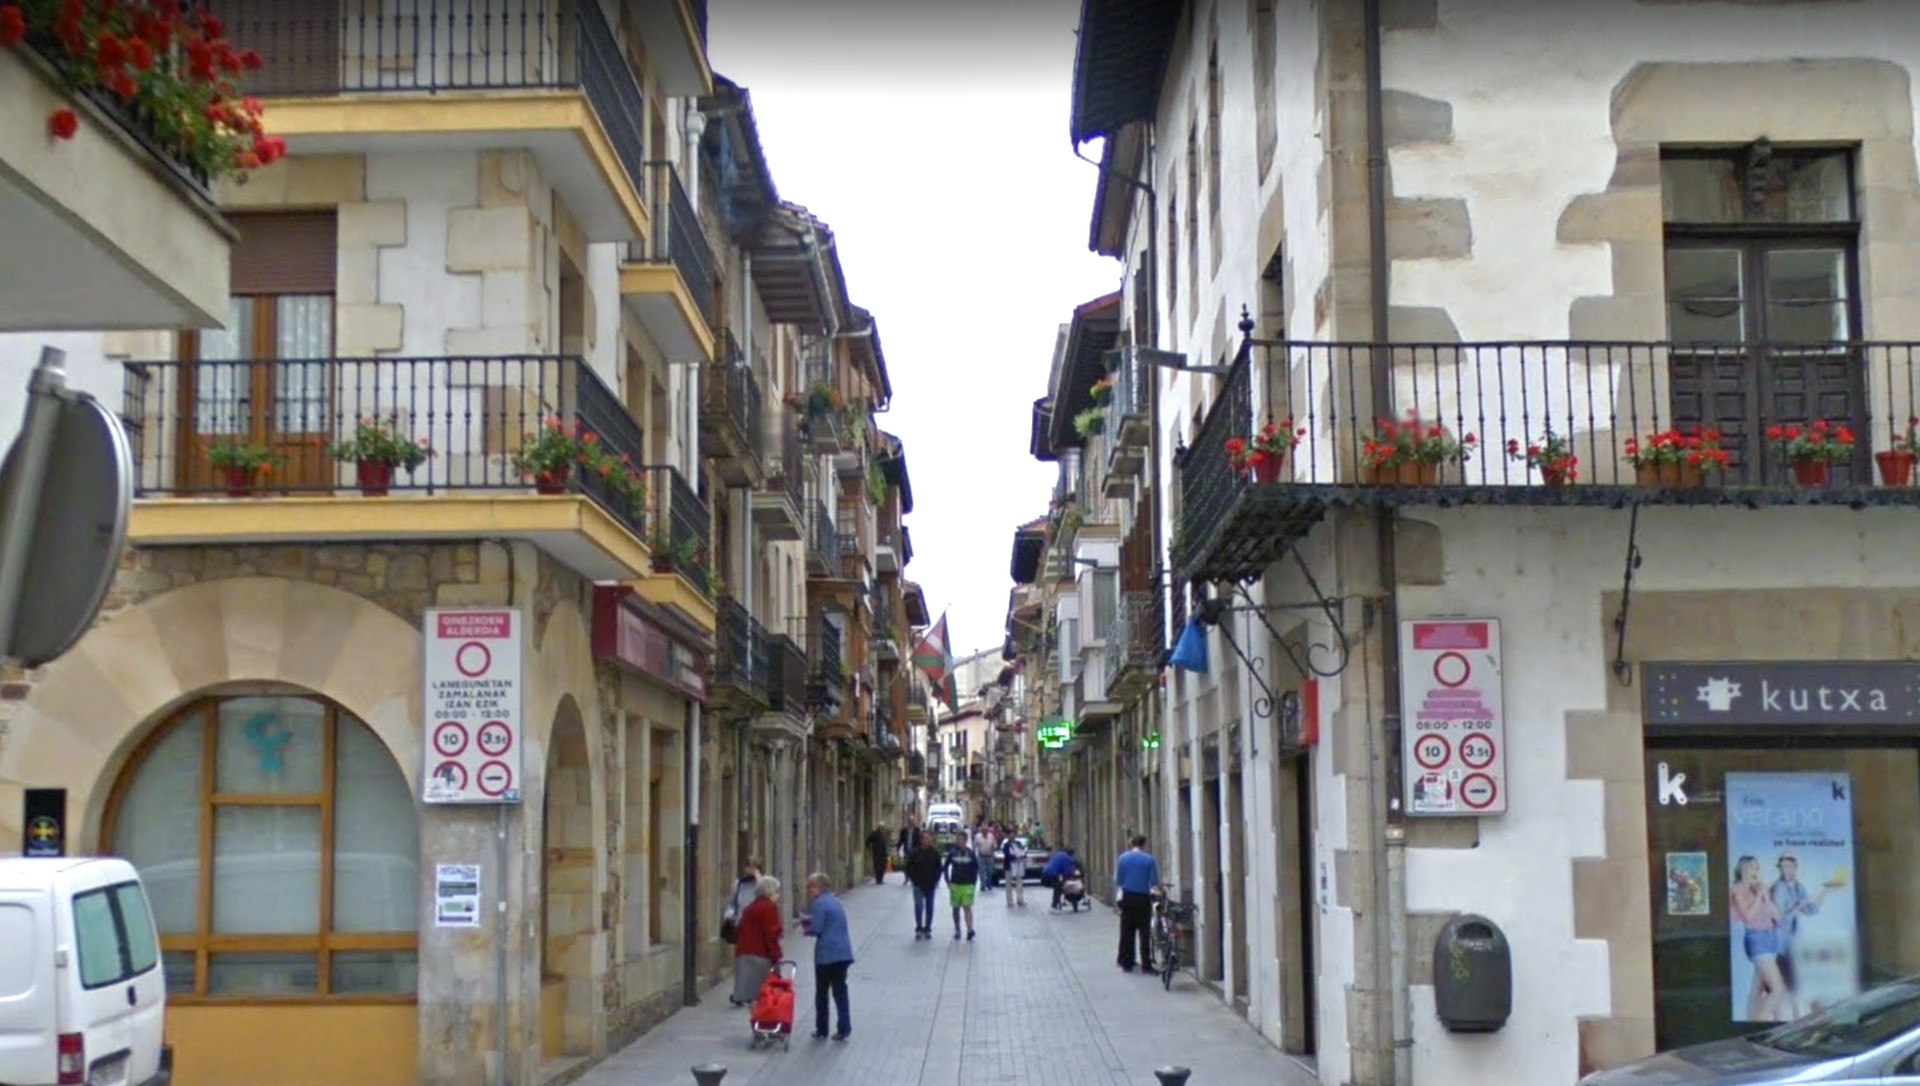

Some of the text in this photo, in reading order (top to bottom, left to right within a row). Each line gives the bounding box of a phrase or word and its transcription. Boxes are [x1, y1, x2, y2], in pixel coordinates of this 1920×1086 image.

[1762, 680, 1888, 711] kutxa
[1462, 720, 1493, 730] 12:00
[443, 733, 459, 745] 10
[1425, 746, 1440, 757] 10
[1657, 762, 1688, 805] k
[1831, 781, 1846, 801] k
